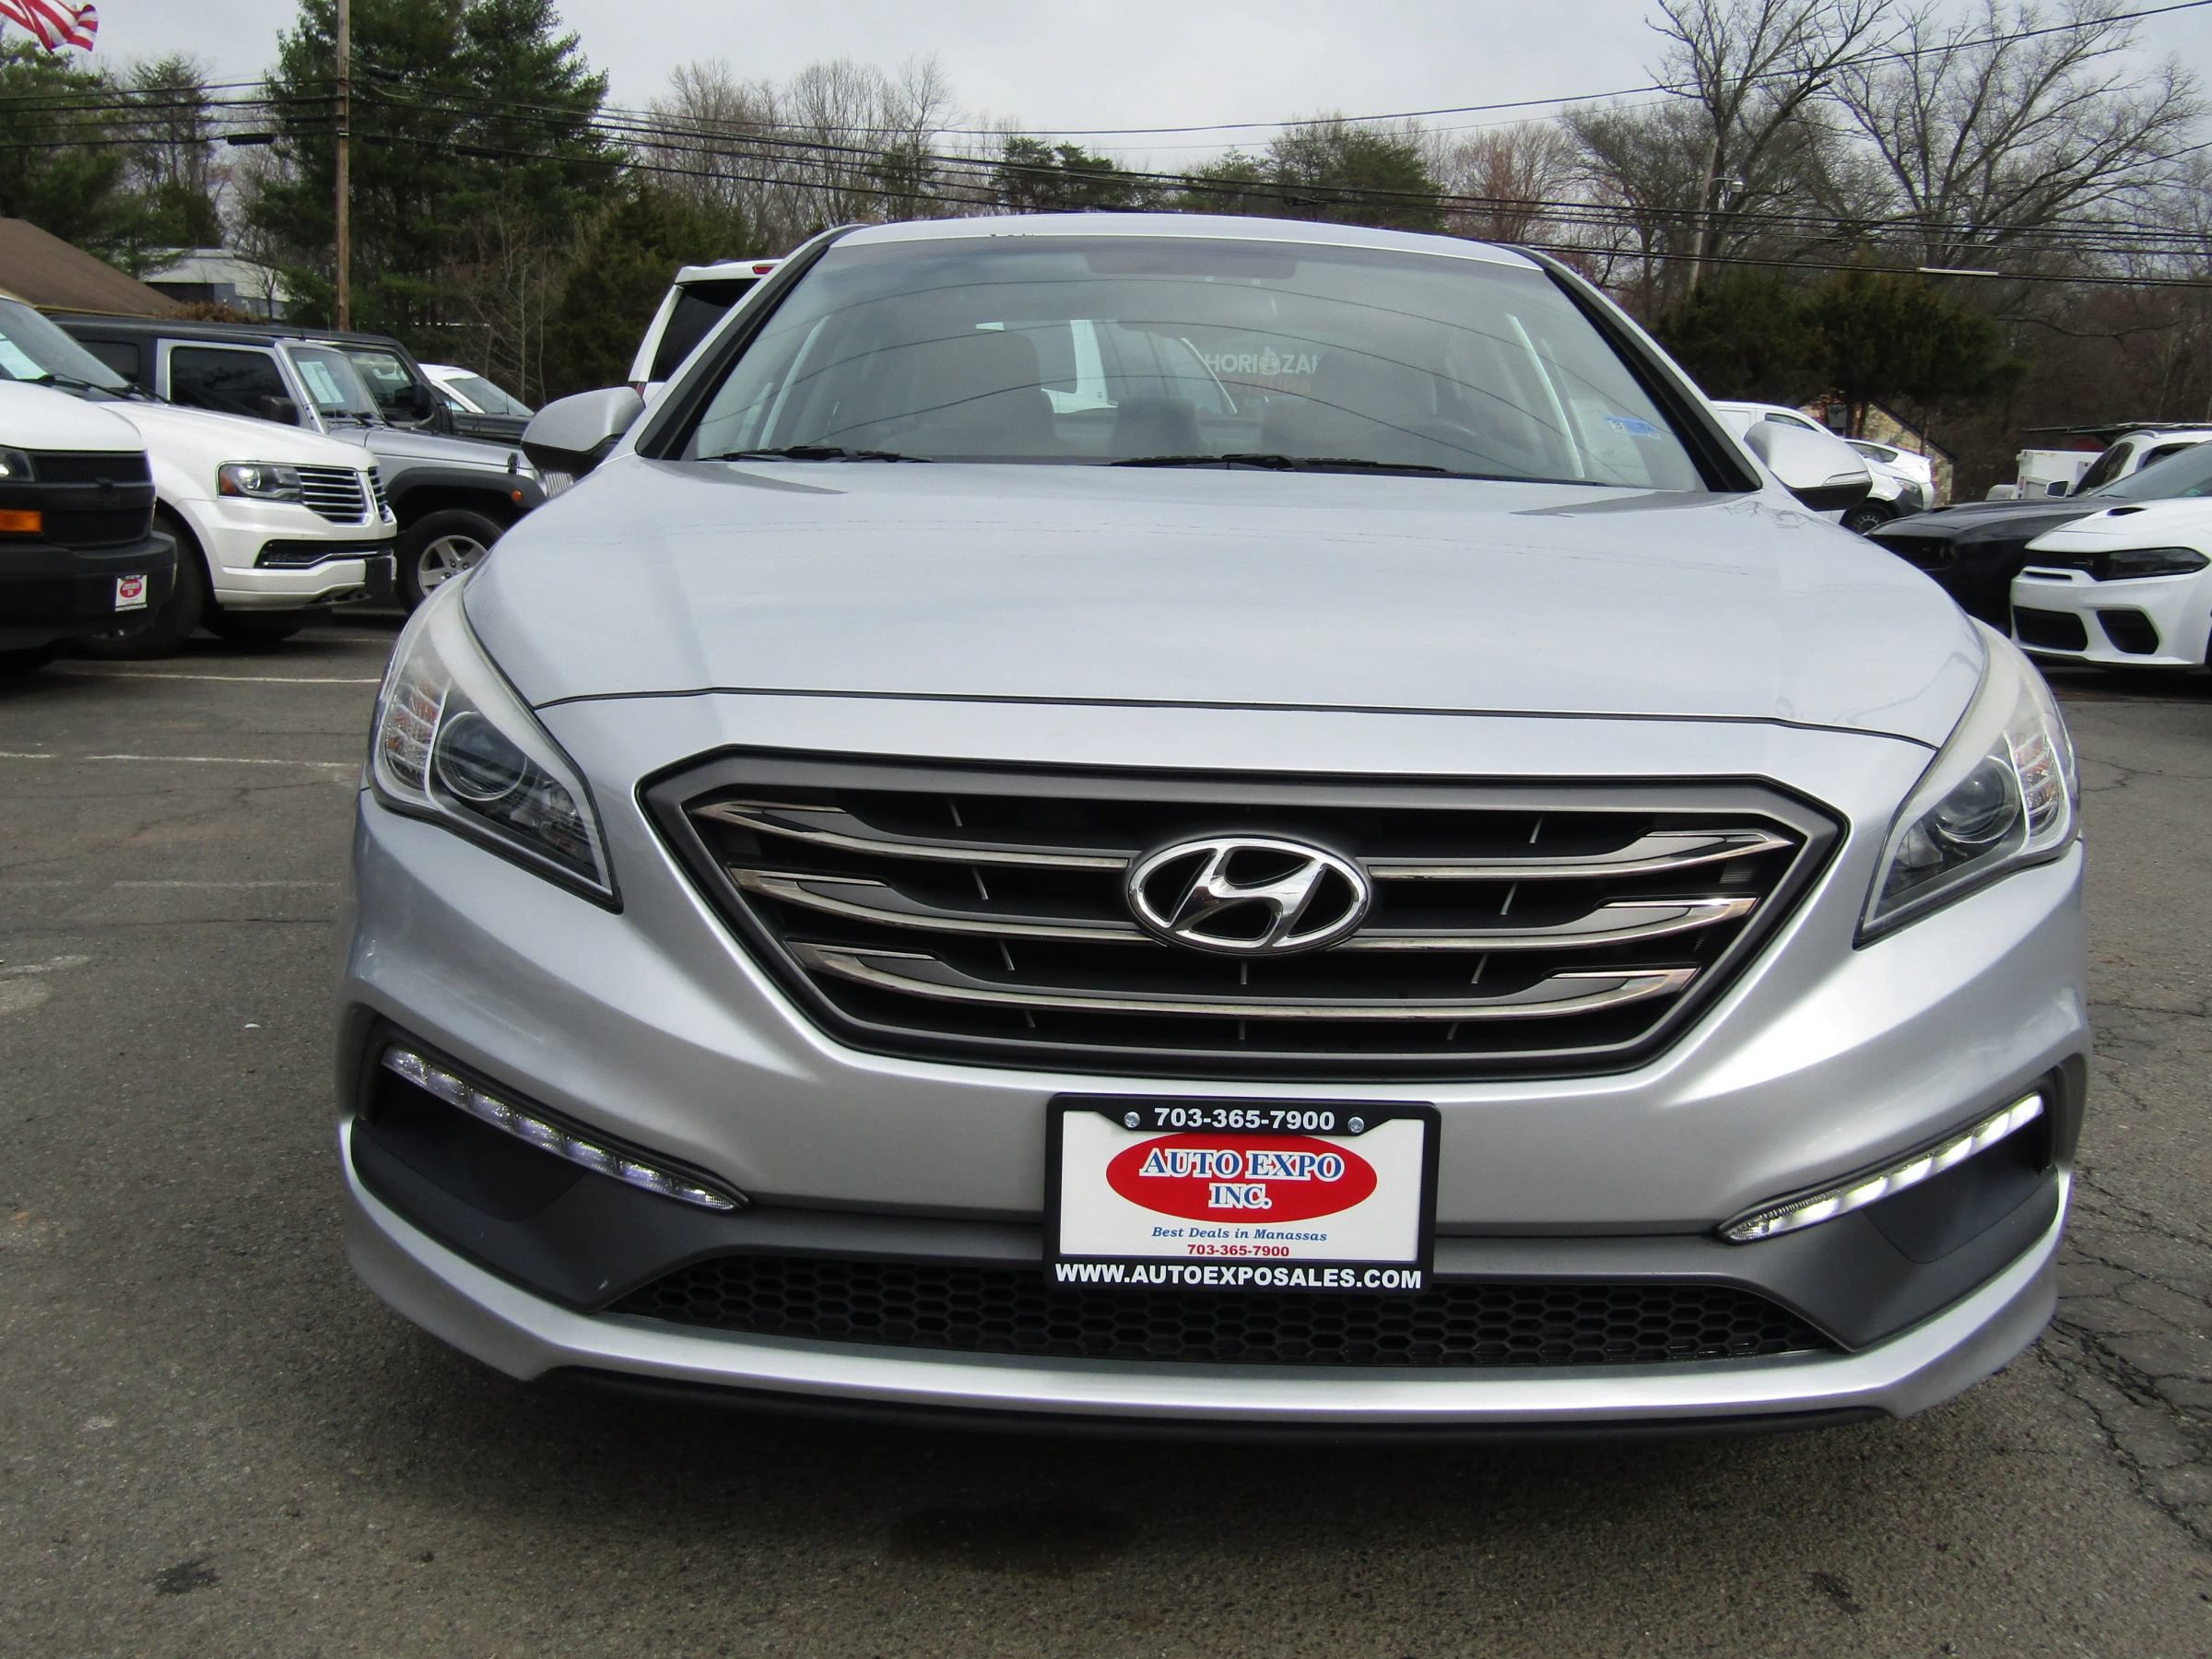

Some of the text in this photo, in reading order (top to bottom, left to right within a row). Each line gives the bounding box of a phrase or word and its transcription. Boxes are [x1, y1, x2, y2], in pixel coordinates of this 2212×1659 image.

[1154, 1107, 1335, 1130] 703-365-7900
[1141, 1148, 1344, 1182] AUTO EXPO
[1209, 1183, 1272, 1208] INC.
[1151, 1227, 1327, 1241] Best Deals in Manassas
[1187, 1244, 1290, 1257] 703-365-7900
[1055, 1264, 1422, 1288] WWW.AUTOEXPOSALES.COM
